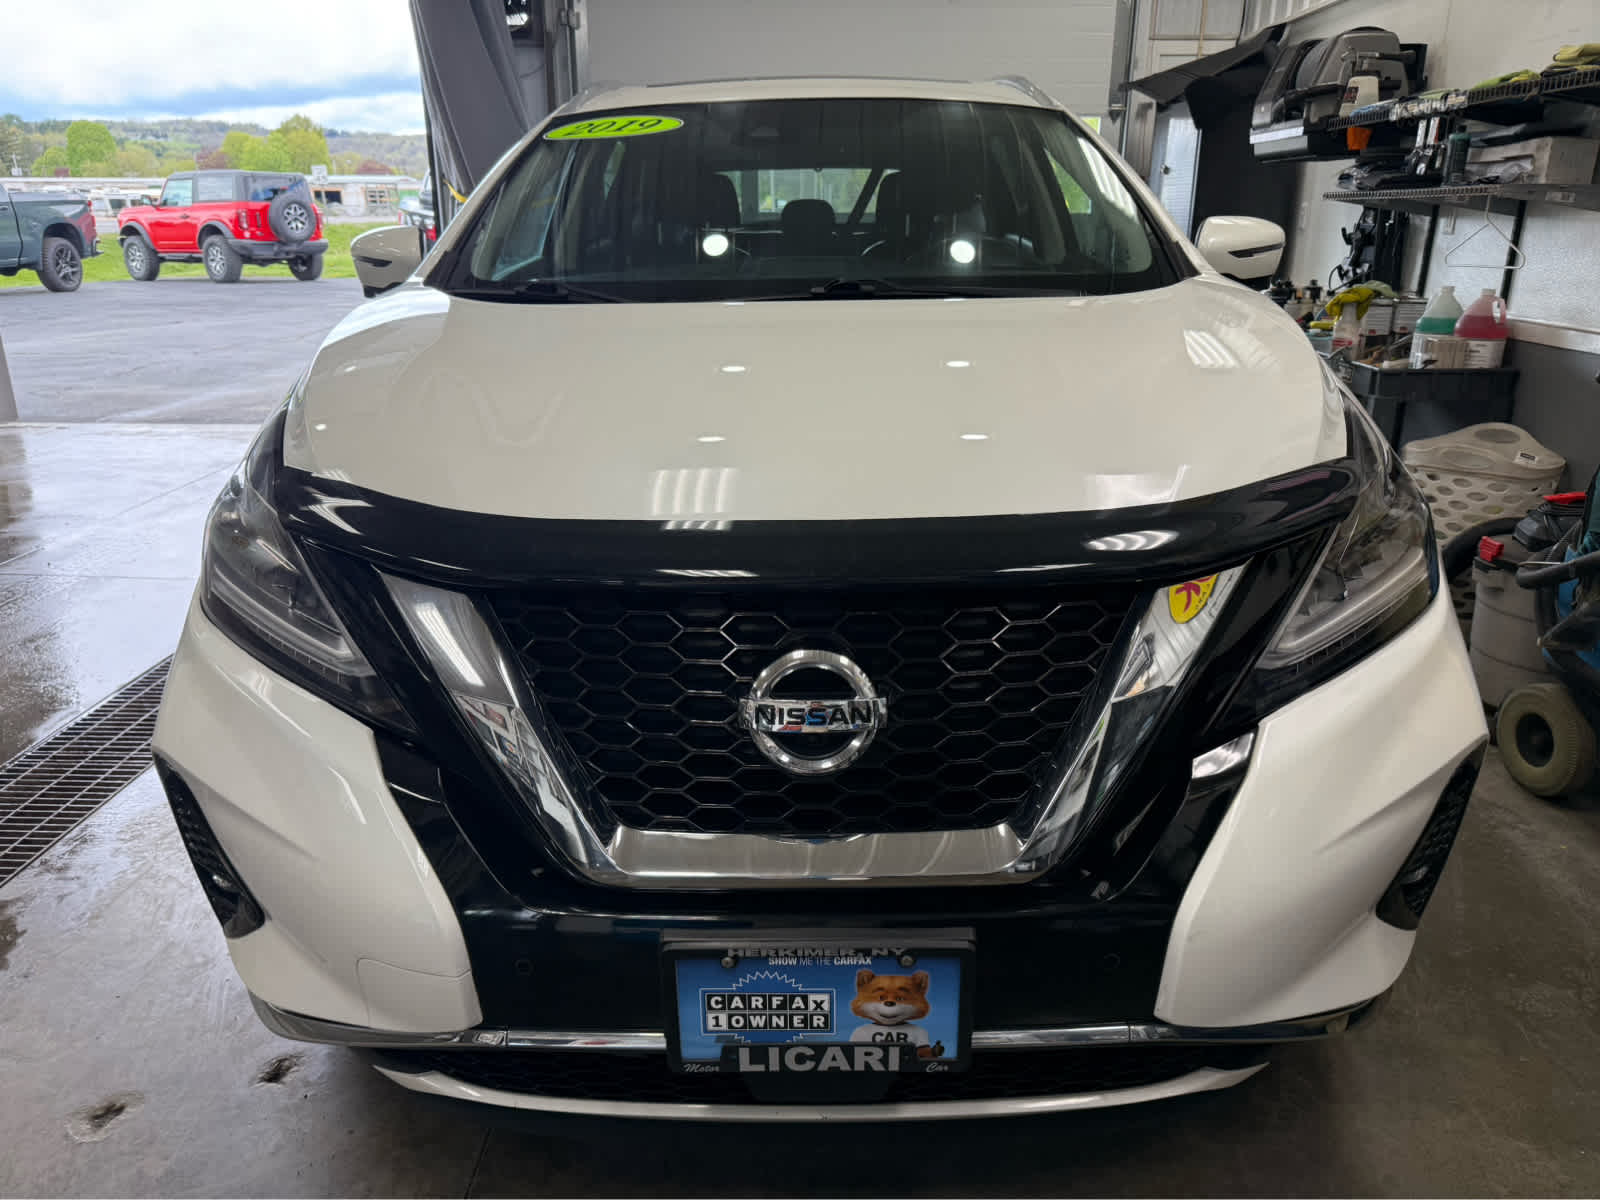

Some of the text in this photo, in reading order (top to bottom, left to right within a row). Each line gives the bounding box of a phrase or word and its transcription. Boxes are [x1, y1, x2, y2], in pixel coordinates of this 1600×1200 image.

[562, 118, 663, 136] 2019
[754, 703, 872, 726] NISSAN
[769, 956, 872, 966] SHOW ME THE CARFAX
[710, 996, 826, 1011] CARFAX
[871, 1032, 909, 1043] CAR
[738, 1046, 901, 1072] LICARI
